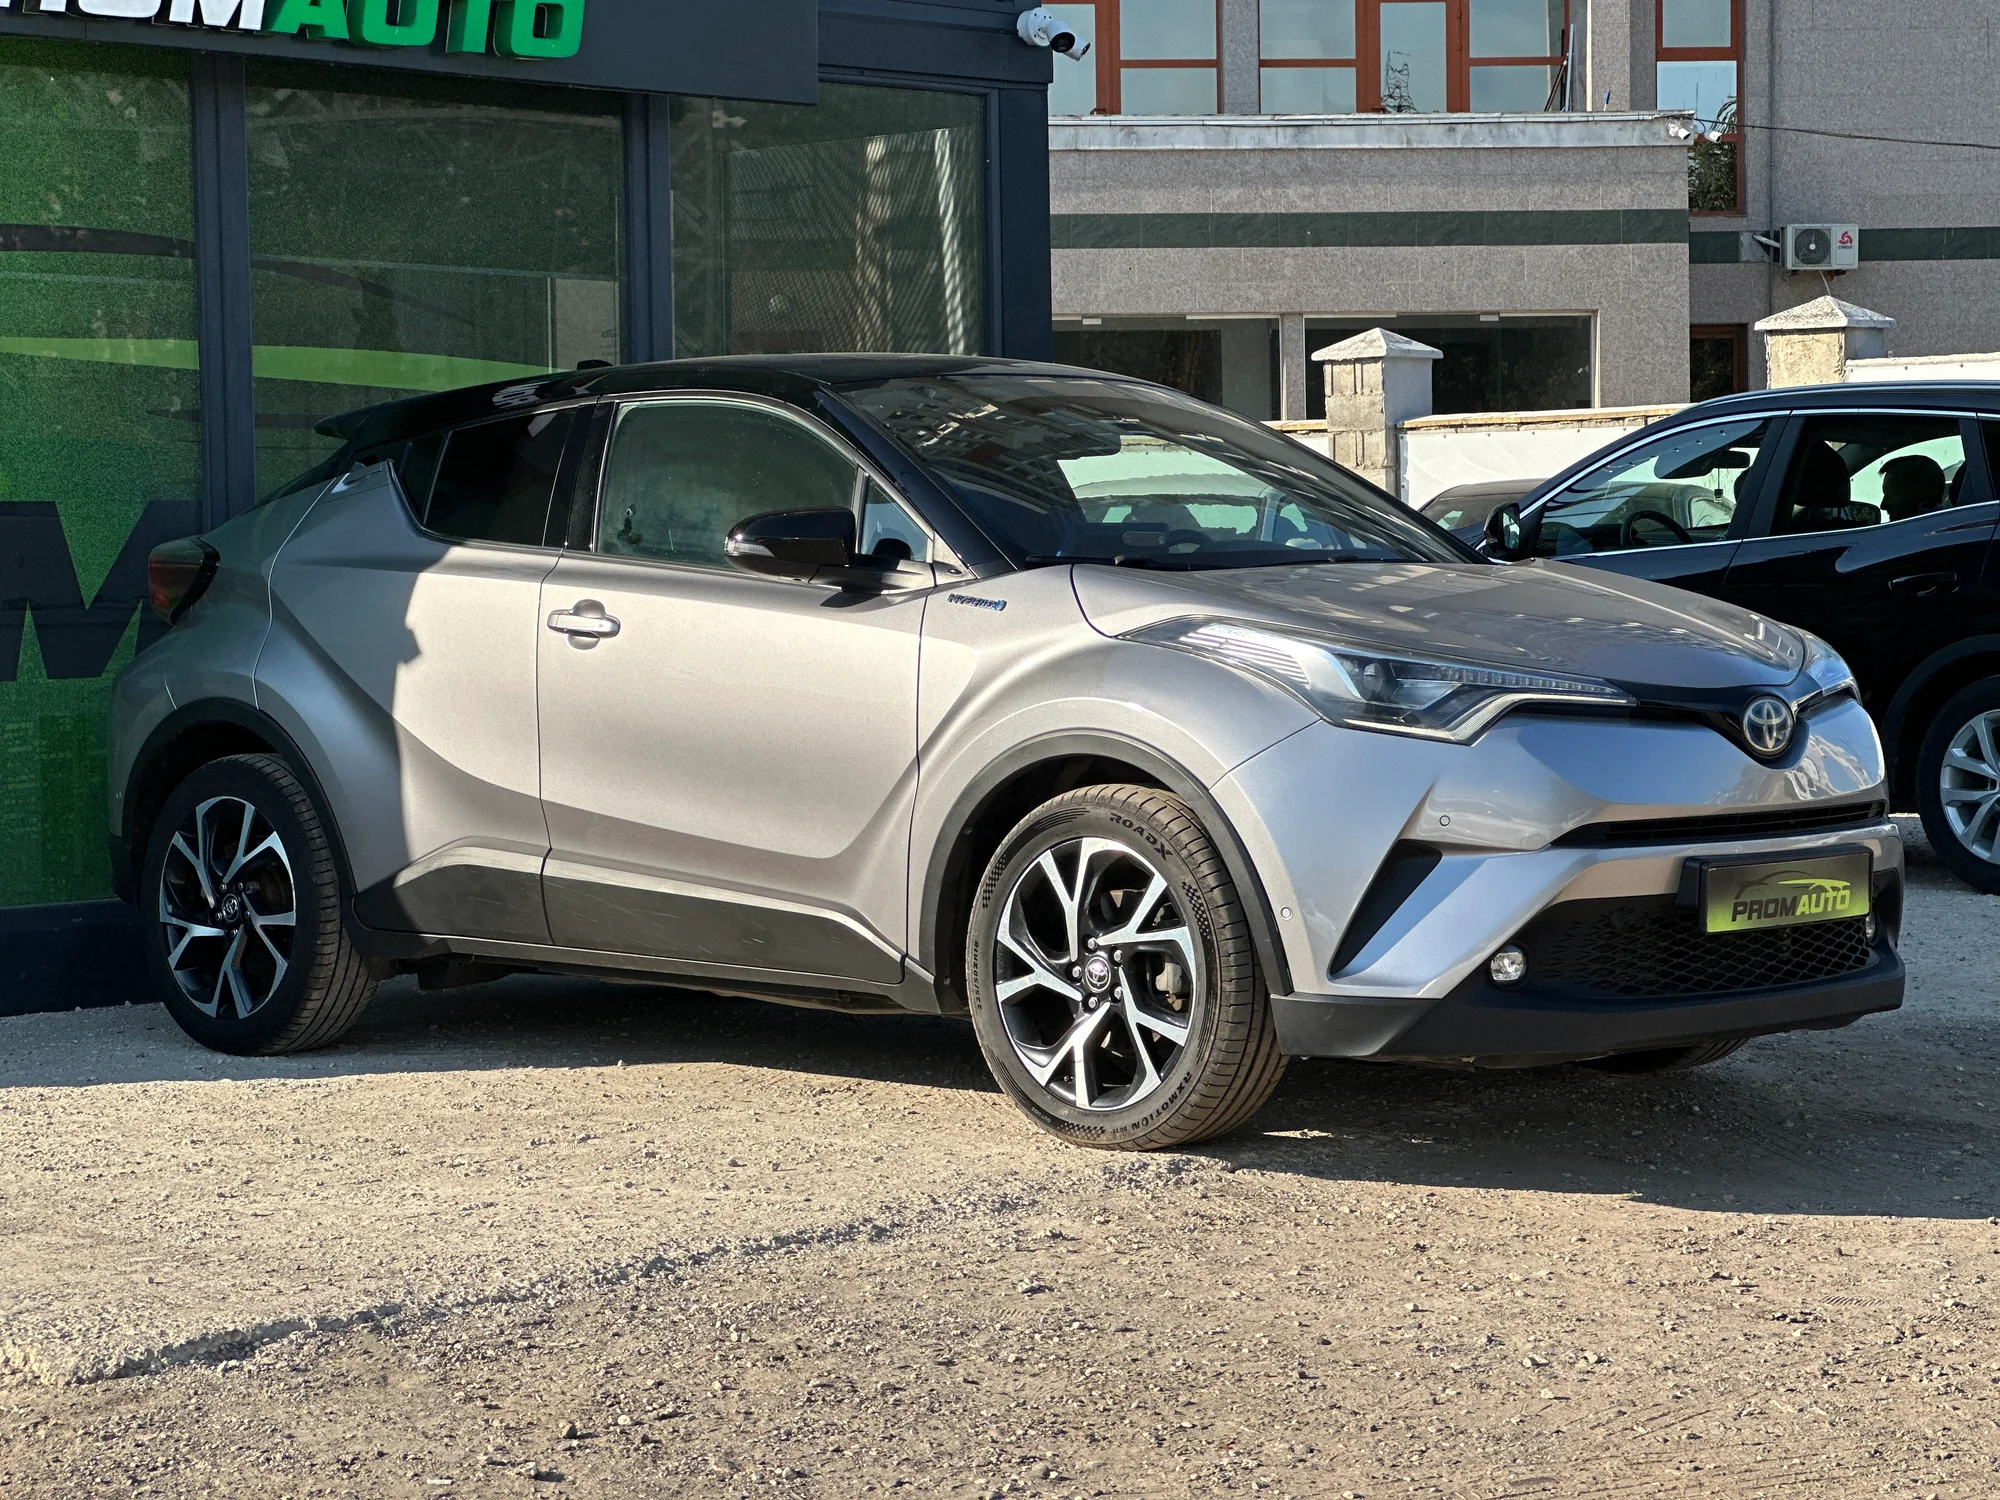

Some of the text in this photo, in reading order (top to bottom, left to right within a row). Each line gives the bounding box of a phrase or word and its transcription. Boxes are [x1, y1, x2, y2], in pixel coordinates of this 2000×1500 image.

[0, 0, 585, 58] AUTO
[1109, 812, 1175, 862] ROADX
[1731, 889, 1851, 922] PROMAUTO
